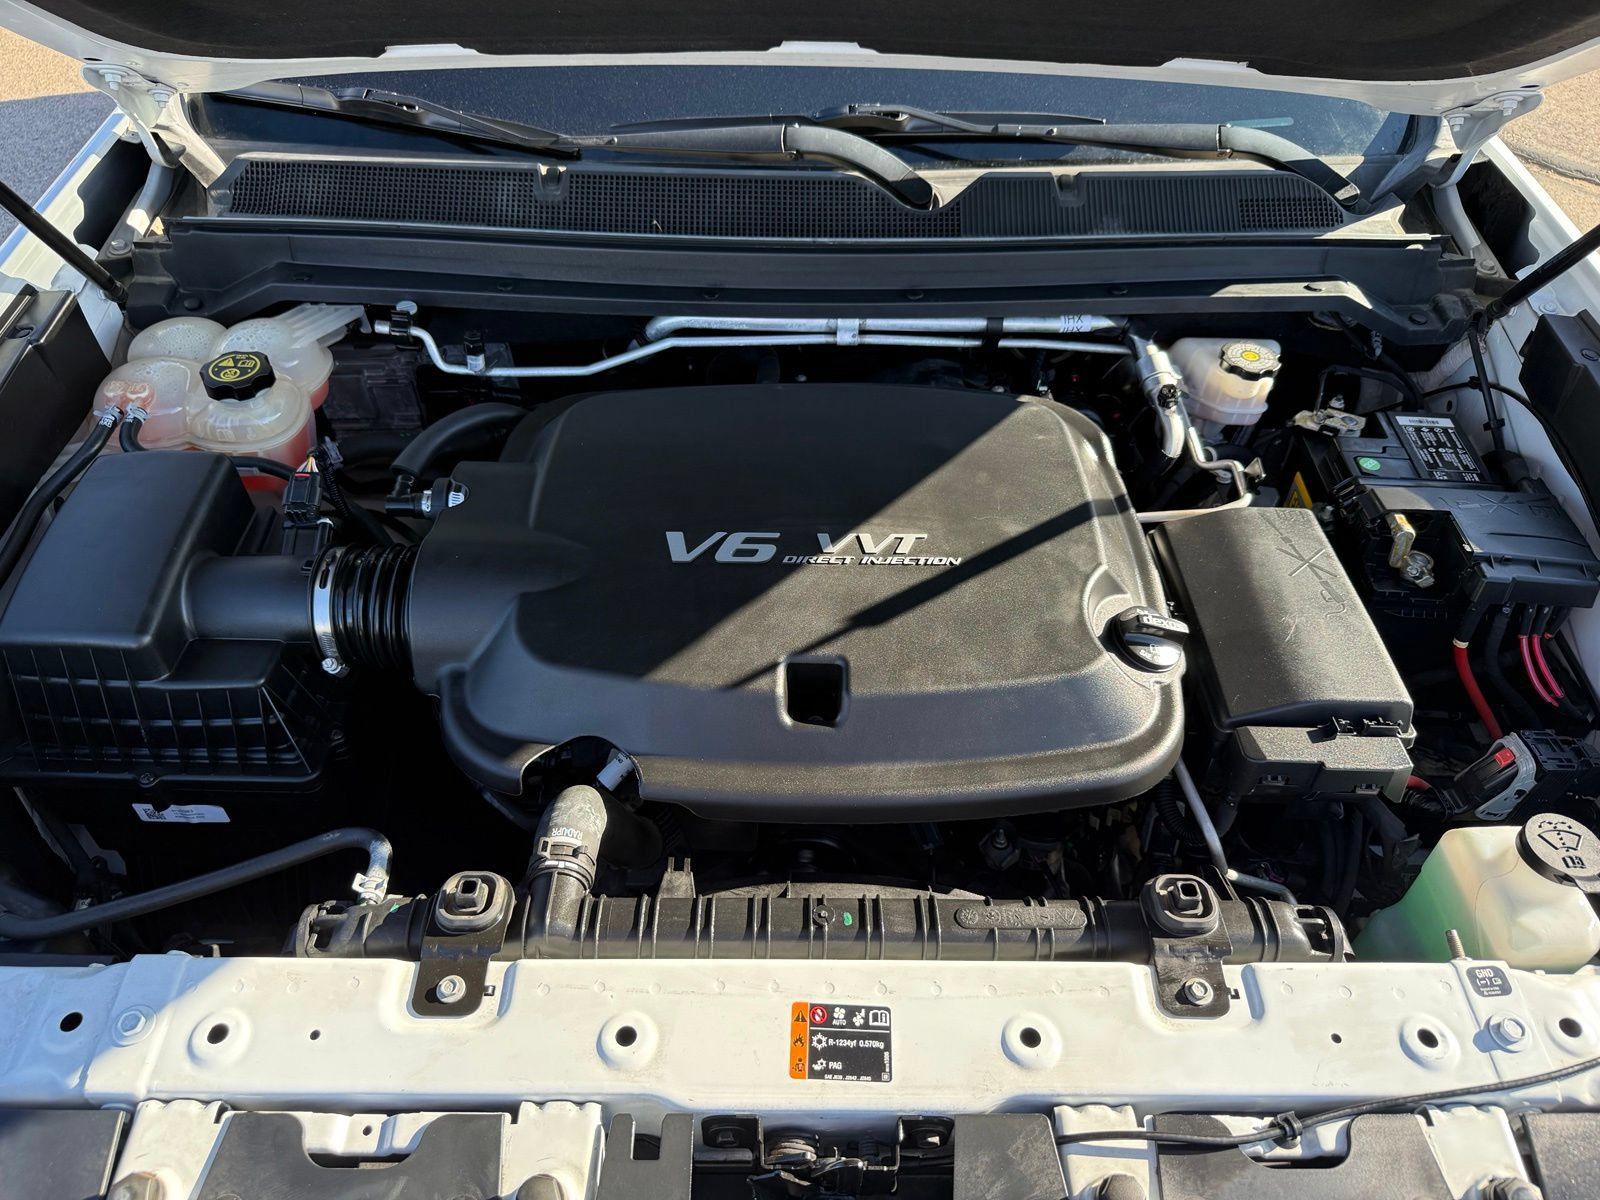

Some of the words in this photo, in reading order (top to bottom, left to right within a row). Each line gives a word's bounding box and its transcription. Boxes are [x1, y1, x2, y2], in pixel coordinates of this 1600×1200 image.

[665, 531, 781, 564] V6
[816, 533, 928, 555] VVT
[782, 555, 856, 565] DIRECT
[861, 556, 962, 566] INJECTION
[1475, 968, 1494, 978] GND
[828, 1038, 857, 1048] R-1234yf
[859, 1039, 885, 1050] 0.570kg
[828, 1061, 843, 1070] PAG
